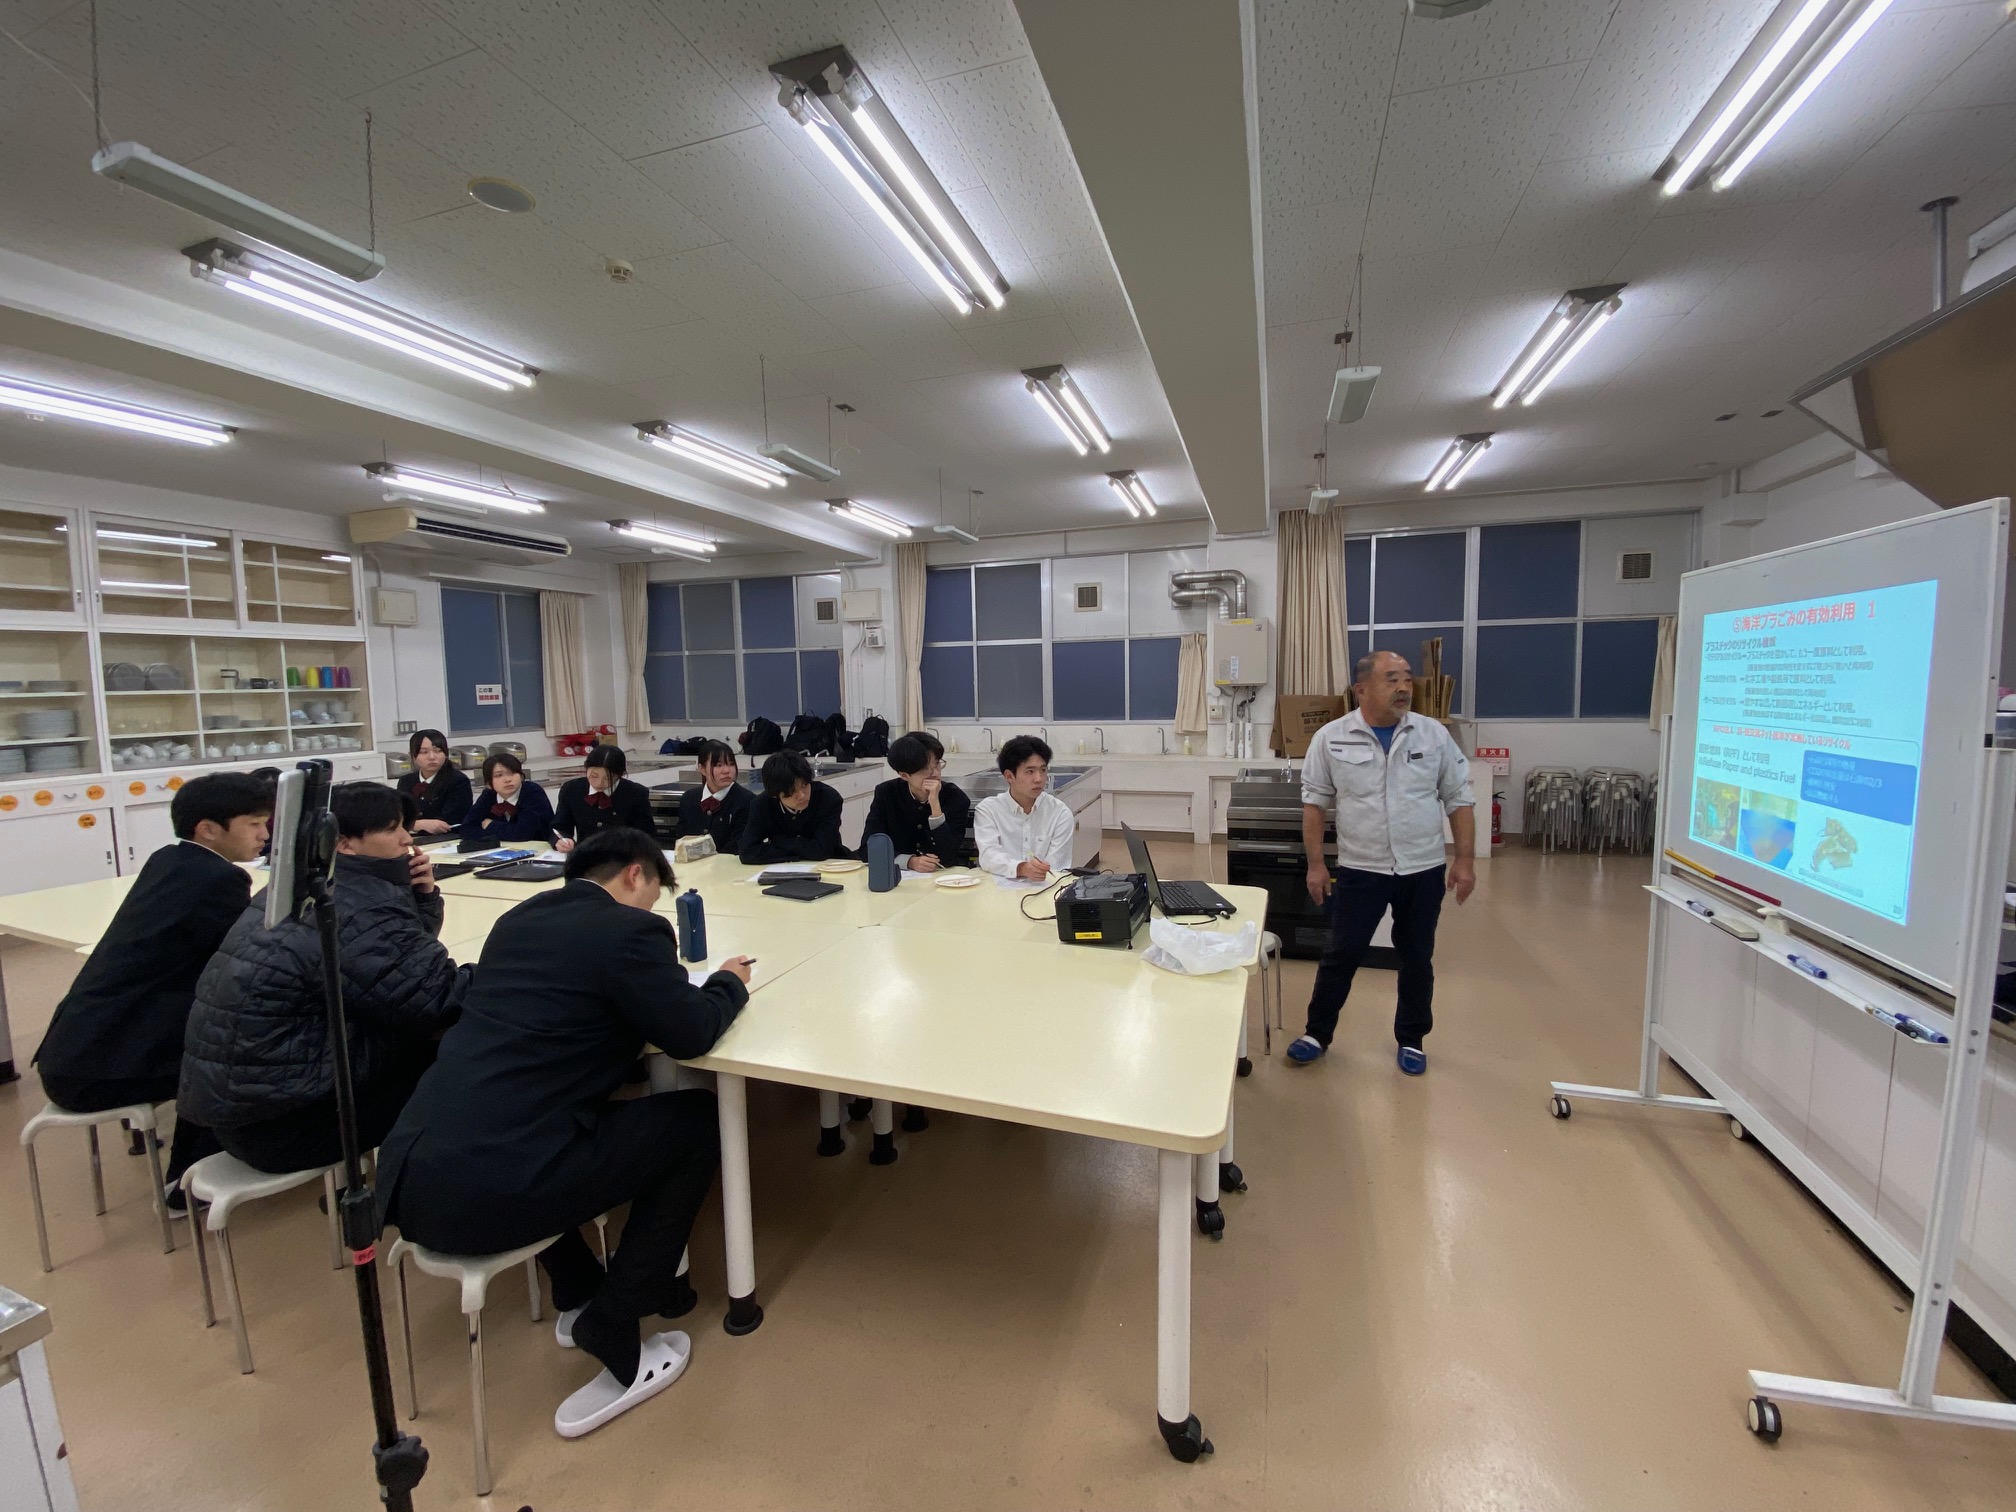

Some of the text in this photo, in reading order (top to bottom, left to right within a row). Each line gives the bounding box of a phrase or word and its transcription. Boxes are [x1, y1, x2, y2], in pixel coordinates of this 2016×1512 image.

[1733, 599, 1877, 632] ⑤海洋プラごみの有効利用 1
[1722, 761, 1739, 774] Paper
[1740, 764, 1753, 776] and
[1753, 767, 1778, 782] plastics
[1779, 771, 1795, 785] Fuel
